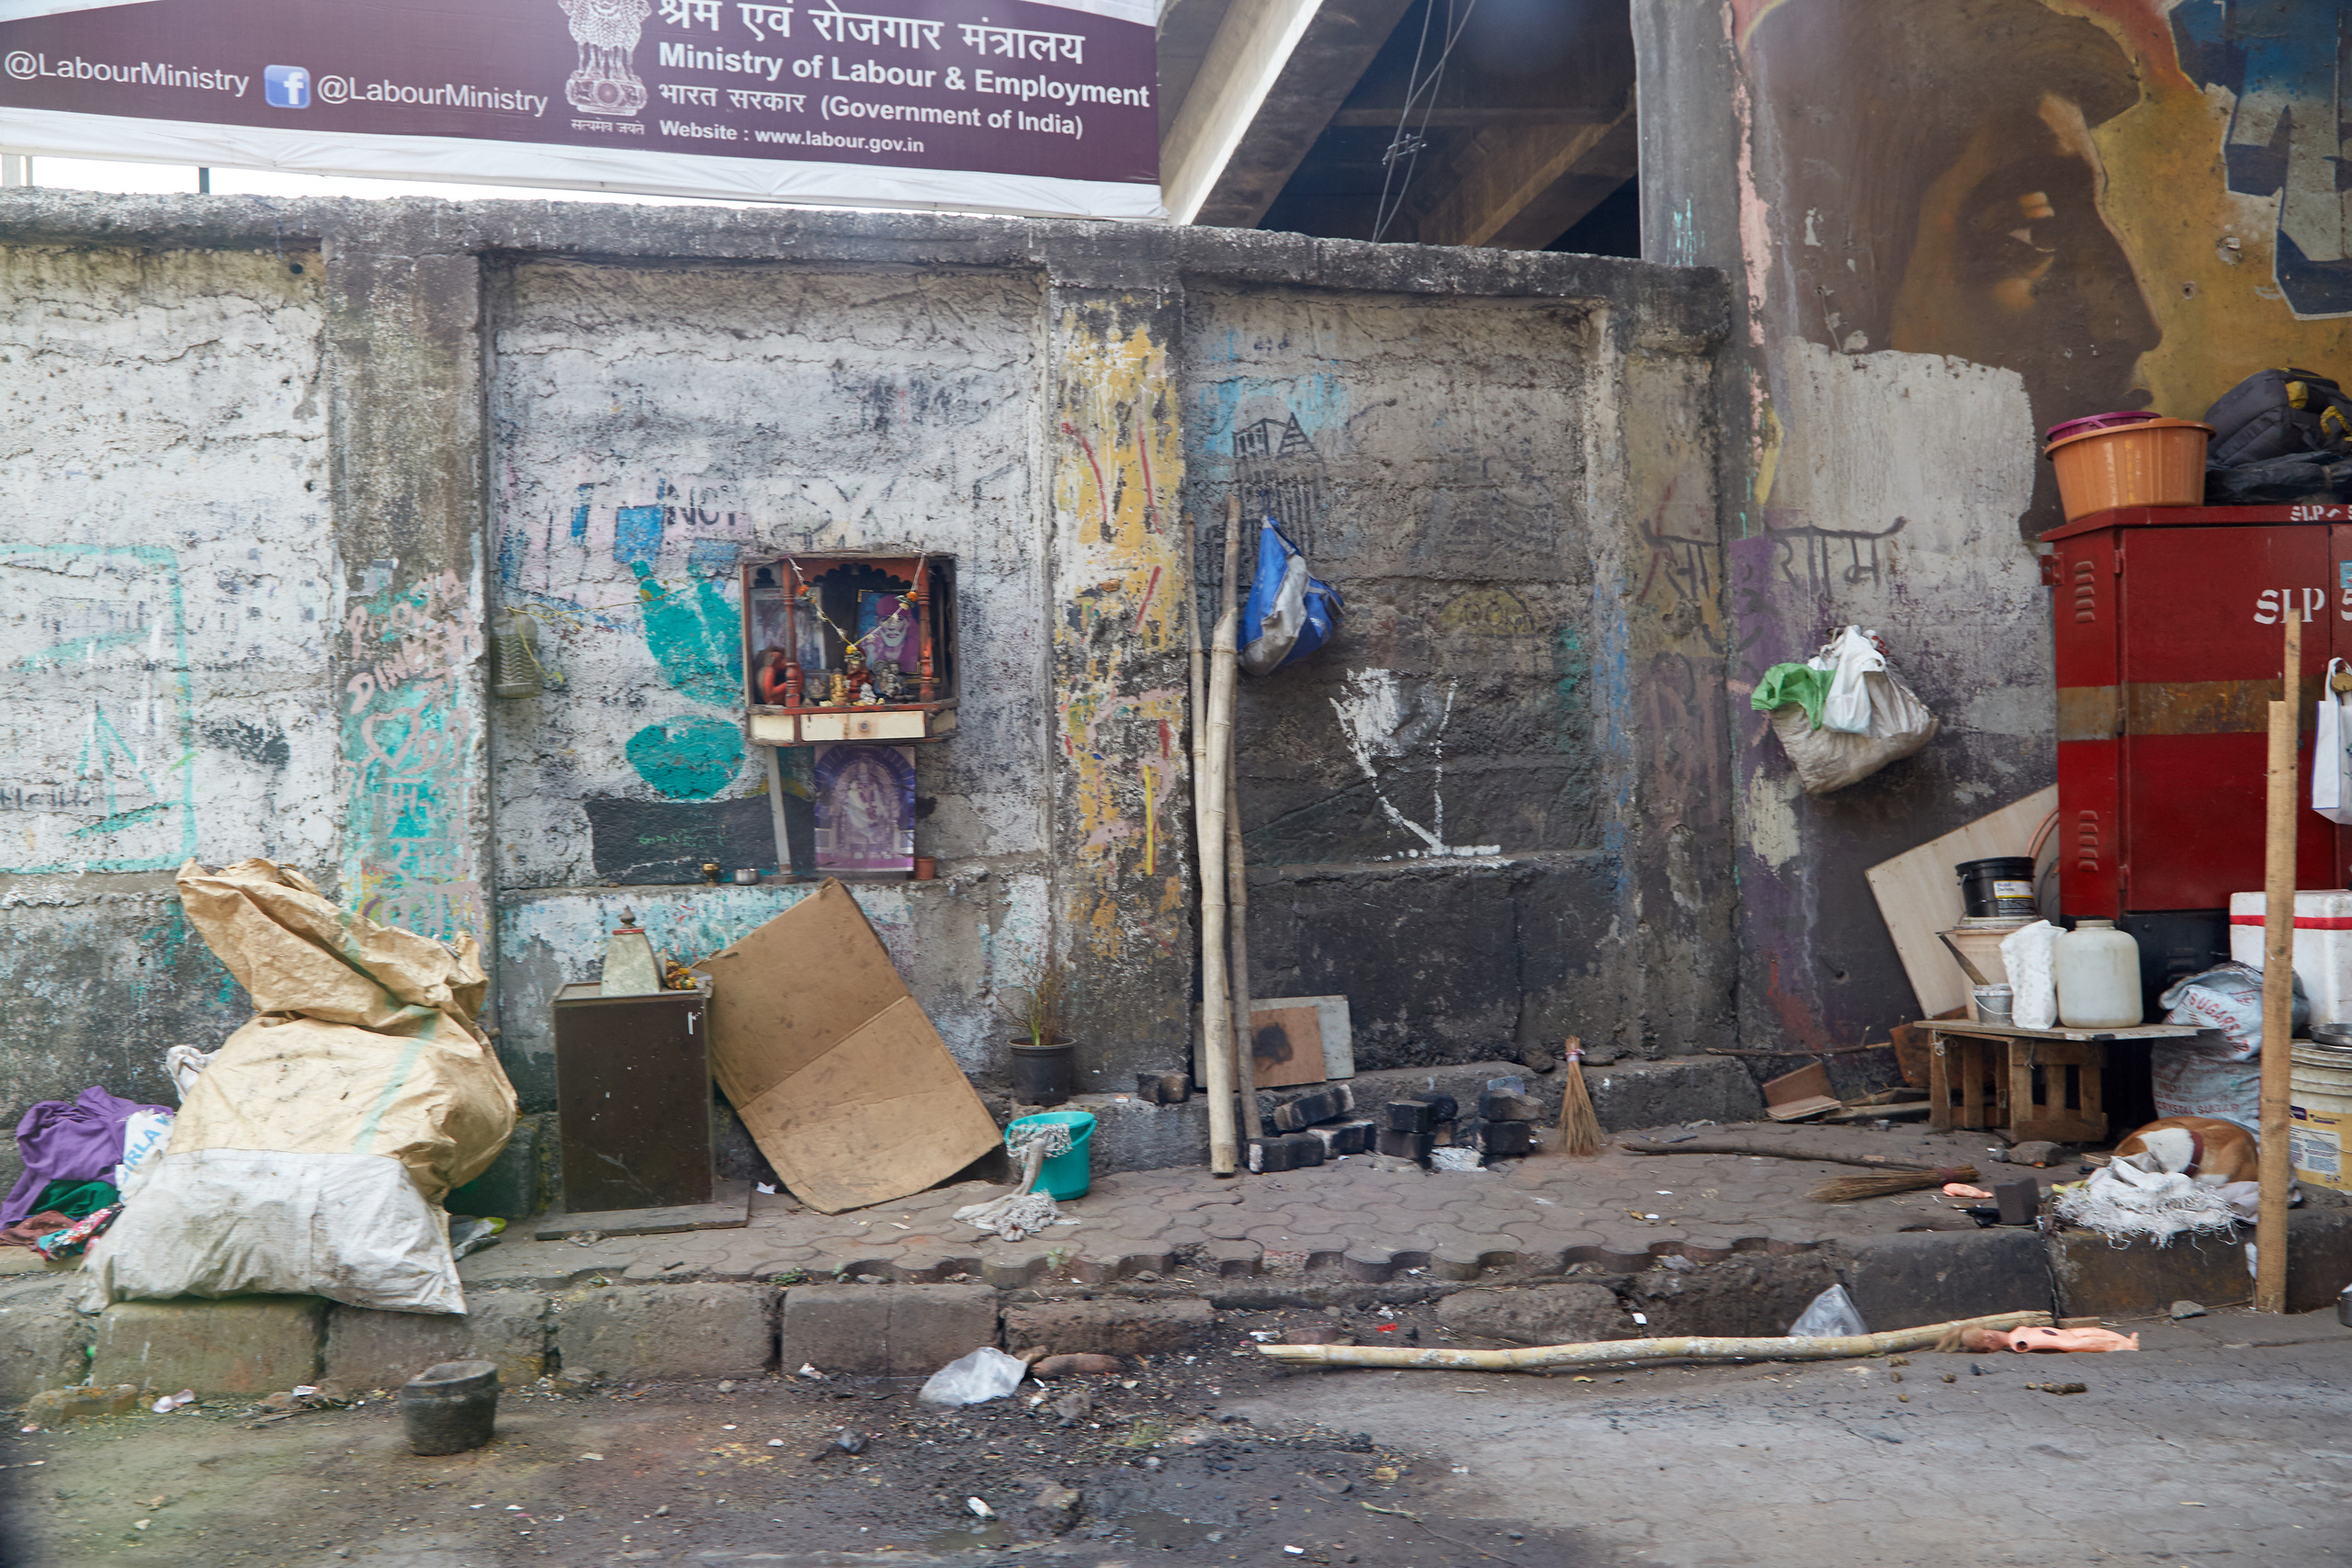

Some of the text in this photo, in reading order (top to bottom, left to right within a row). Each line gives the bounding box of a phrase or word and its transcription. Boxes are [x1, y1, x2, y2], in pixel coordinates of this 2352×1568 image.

[658, 0, 723, 31] श्रम
[808, 0, 945, 51] रोजगार
[957, 17, 1086, 64] मंत्रालय
[4, 51, 249, 97] @LabourMinistry
[659, 42, 1150, 107] Ministry of Labour & Employment
[318, 75, 548, 117] @LabourMinistry
[658, 84, 808, 113] भारत सरकार
[571, 118, 645, 135] सत्यमेव जयते
[659, 120, 739, 141] Website
[754, 130, 925, 153] www.labour.gov.in
[820, 95, 1083, 140] (Government of India)
[2197, 1103, 2240, 1114] SUGAR
